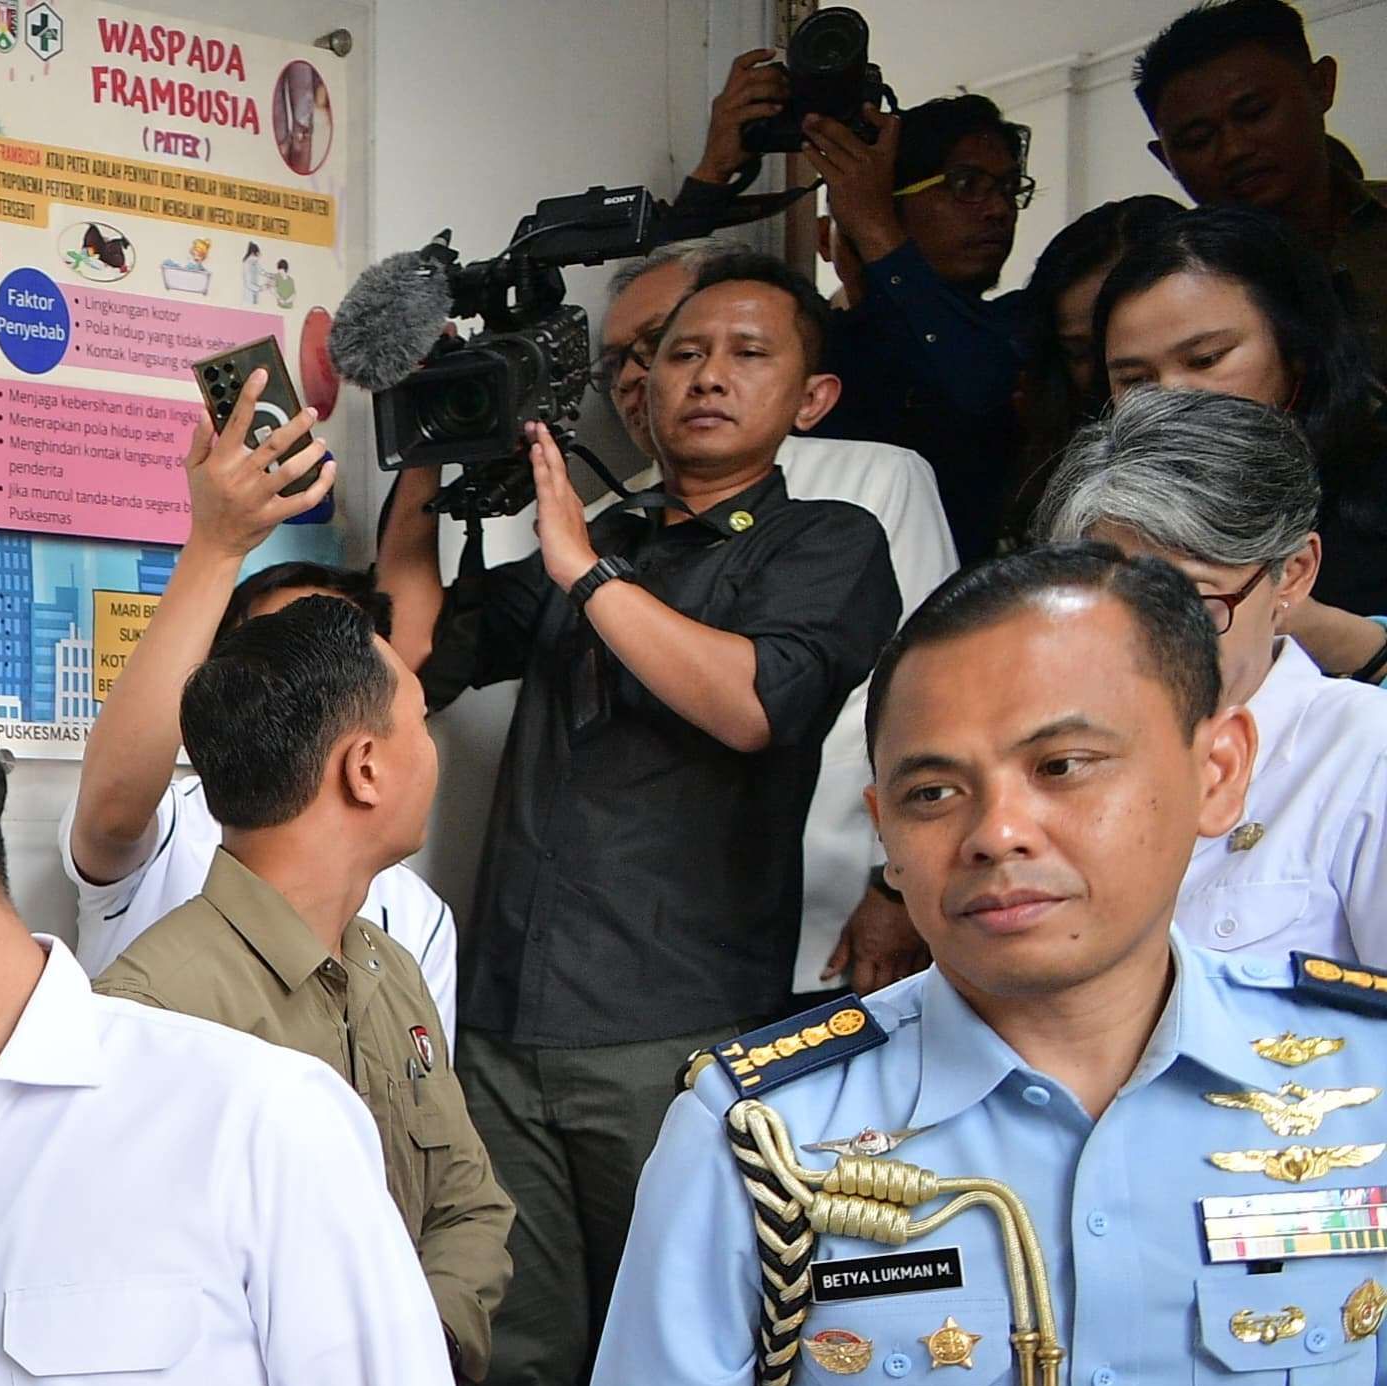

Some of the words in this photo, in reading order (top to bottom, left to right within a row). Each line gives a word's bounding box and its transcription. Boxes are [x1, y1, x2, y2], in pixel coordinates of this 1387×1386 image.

[97, 18, 246, 82] WASPADA
[91, 66, 260, 135] FRAMBUSIA
[45, 152, 65, 171] ATAU
[67, 155, 90, 174] PATEK
[92, 160, 121, 179] ADALAH
[123, 164, 159, 186] PENYAKIT
[603, 194, 637, 206] SONY
[7, 288, 55, 311] Faktor
[85, 296, 150, 319] Lingkungan
[152, 308, 181, 323] kotor
[85, 320, 110, 336] Pola
[113, 323, 145, 341] hidup
[148, 331, 173, 346] yang
[176, 333, 203, 349] tidak
[86, 344, 126, 361] Kontak
[128, 349, 179, 371] langsung
[9, 388, 58, 410] Menjaga
[61, 394, 123, 415] kebersihan
[125, 401, 143, 416] diri
[146, 404, 167, 419] dan
[169, 406, 203, 426] lingku
[9, 412, 81, 433] Menerapkan
[84, 422, 108, 436] pola
[111, 423, 143, 442] hidup
[145, 429, 175, 444] sehat
[9, 436, 81, 456] Menghindari
[84, 445, 121, 461] kontak
[124, 450, 173, 470] langsung
[9, 461, 64, 478] penderita
[8, 483, 28, 499] Jika
[31, 487, 73, 502] muncul
[76, 491, 142, 509] tanda-tanda
[145, 499, 181, 514] segera
[9, 506, 72, 525] Puskesmas
[110, 602, 141, 618] MARI
[100, 654, 126, 668] KOT
[822, 1270, 870, 1289] BETYA
[872, 1262, 934, 1284] LUKMAN
